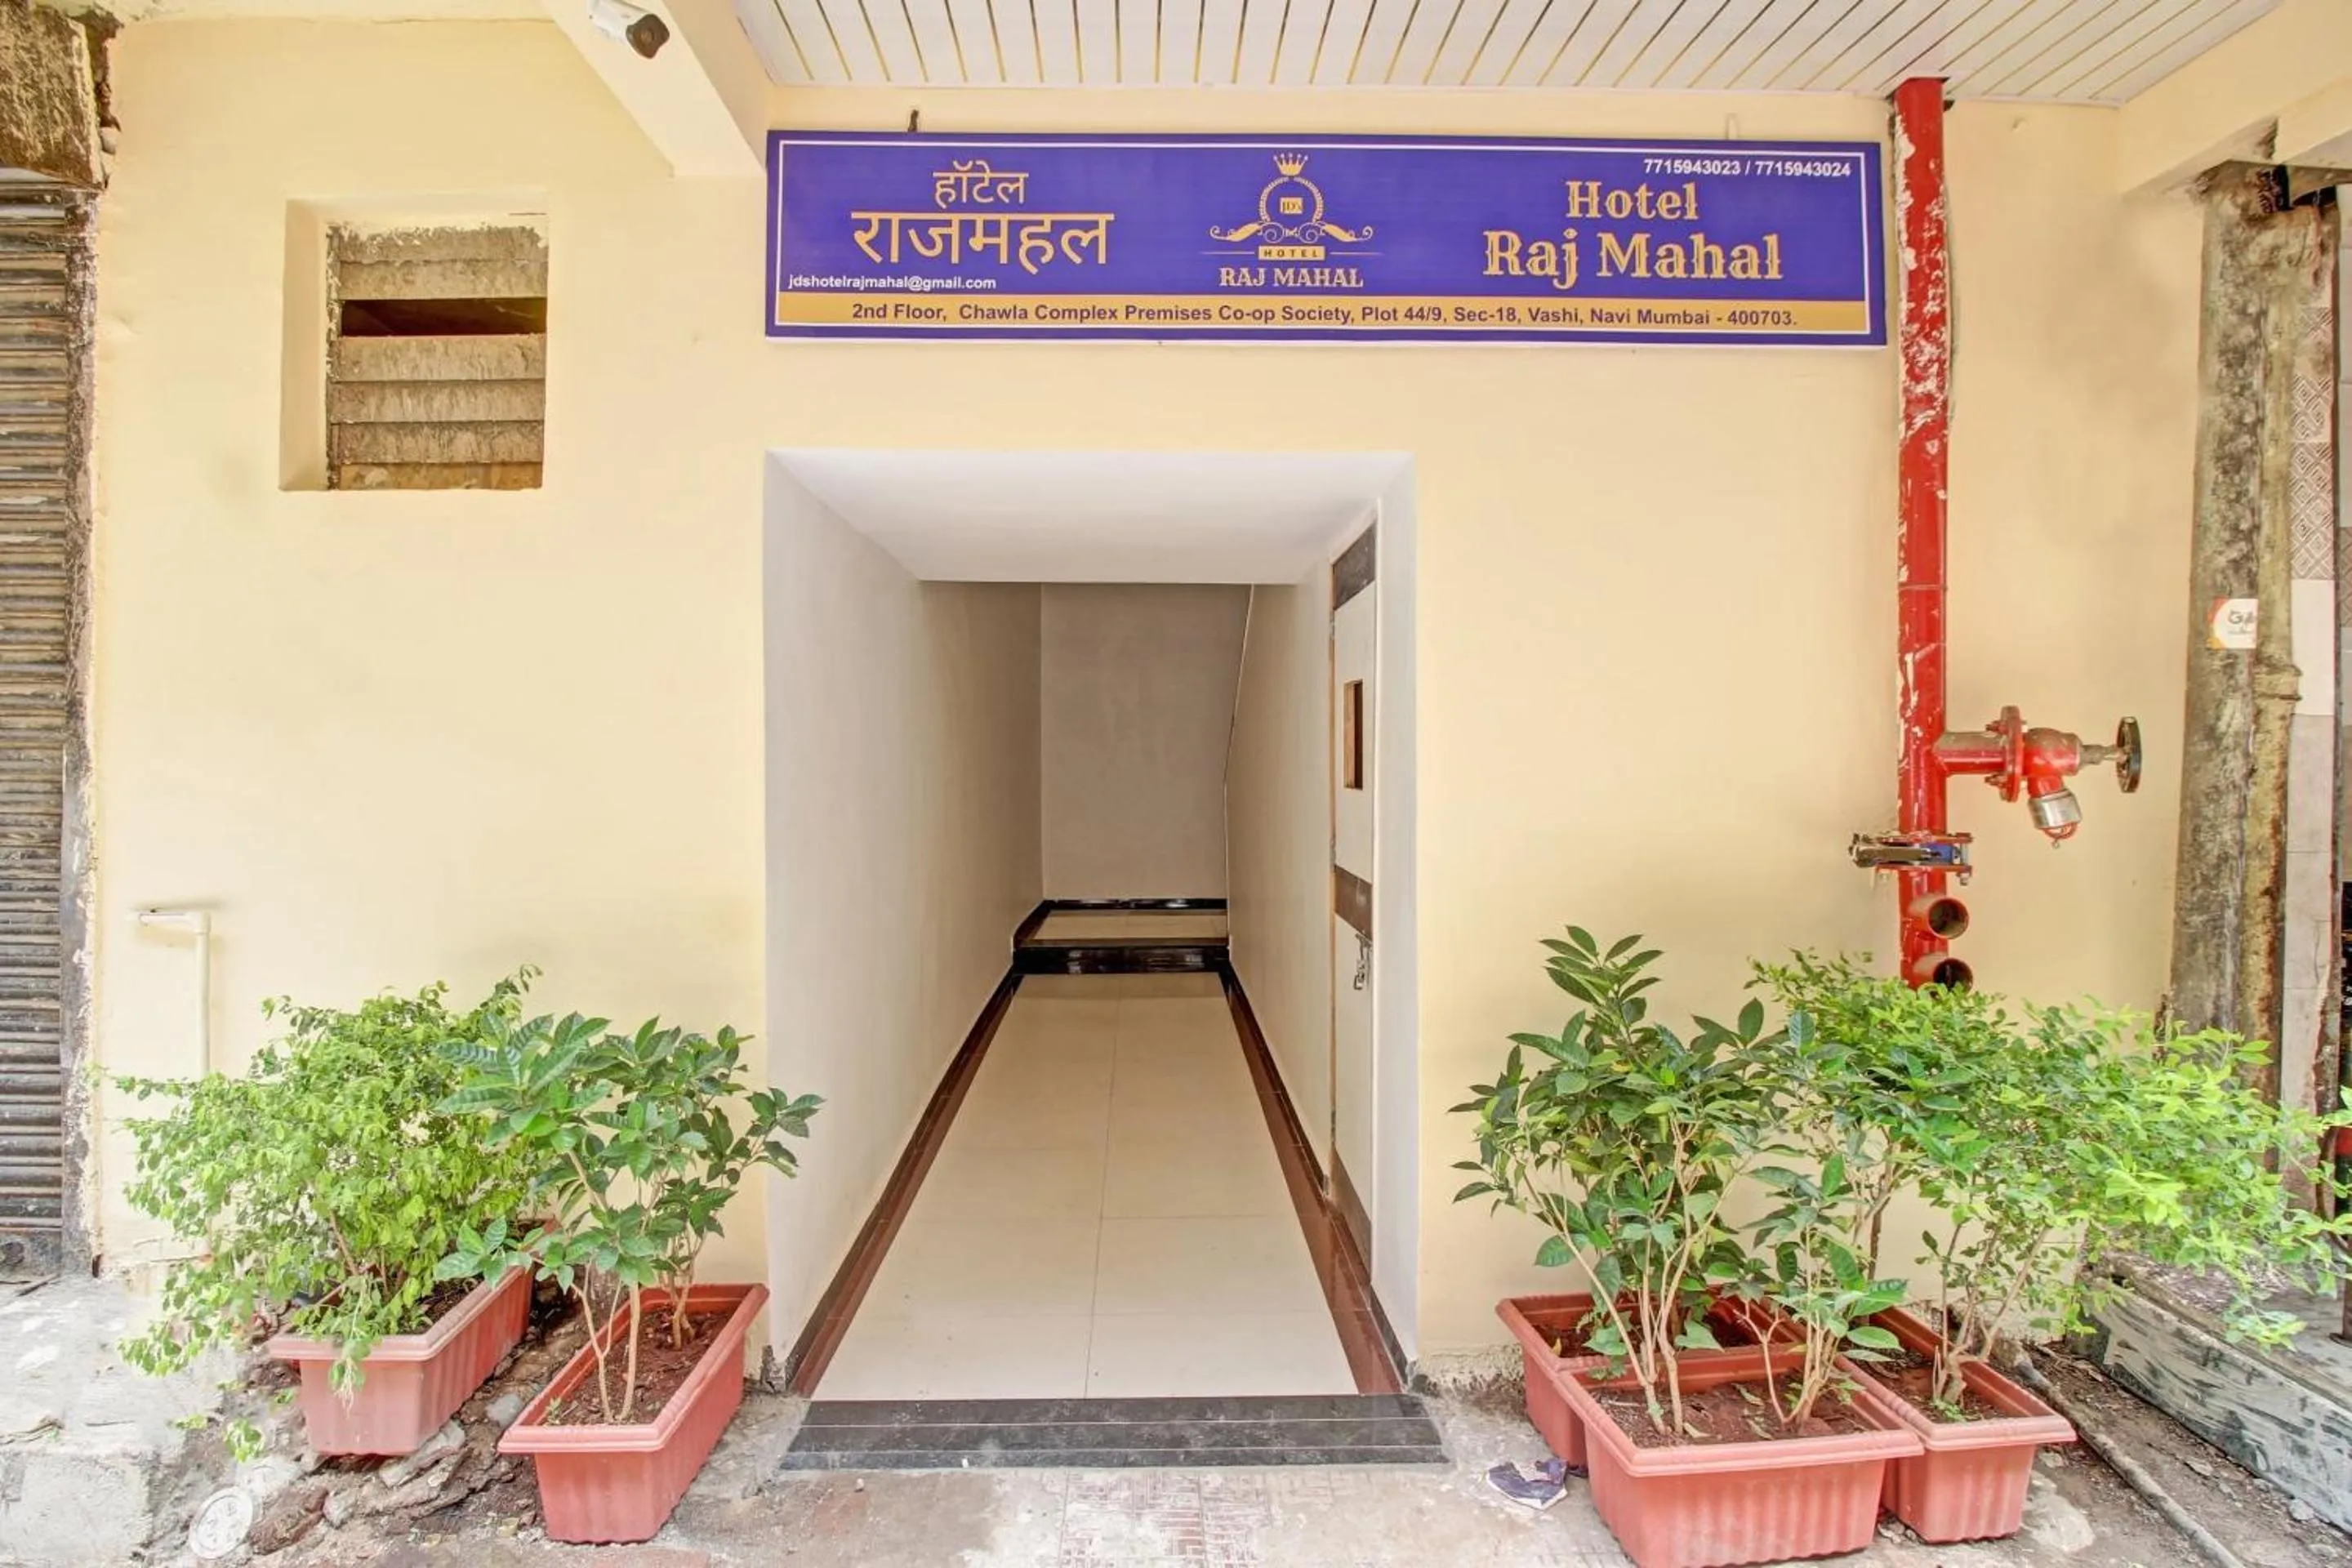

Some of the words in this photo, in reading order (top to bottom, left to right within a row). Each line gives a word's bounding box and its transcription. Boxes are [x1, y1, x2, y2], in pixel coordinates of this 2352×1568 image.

[1643, 158, 1741, 175] 7715943023
[1754, 161, 1851, 176] 7715943024
[933, 159, 1029, 208] हॉटेल
[1566, 180, 1699, 220] Hotel
[850, 211, 1116, 275] राजमहल
[1263, 249, 1319, 258] HOTEL
[1482, 228, 1579, 290] Raj
[1596, 232, 1784, 280] Mahal
[788, 274, 997, 292] jdshotelrajmahal@gmail.com
[1218, 267, 1267, 287] RAJ
[1273, 267, 1364, 288] MAHAL
[853, 303, 888, 318] 2nd
[893, 303, 947, 323] Floor,
[959, 304, 1028, 319] Chawla
[1035, 305, 1118, 324] Complex
[1125, 305, 1212, 320] Premises
[1218, 305, 1276, 324] Co-op
[1281, 305, 1356, 323] Society,
[1361, 306, 1398, 322] Plot
[1404, 306, 1448, 323] 44/9,
[1454, 306, 1522, 325] Sec-18,
[1528, 307, 1584, 325] Vashi,
[1590, 308, 1630, 323] Navi
[1637, 309, 1710, 325] Mumbai
[1727, 310, 1797, 326] 400703.
